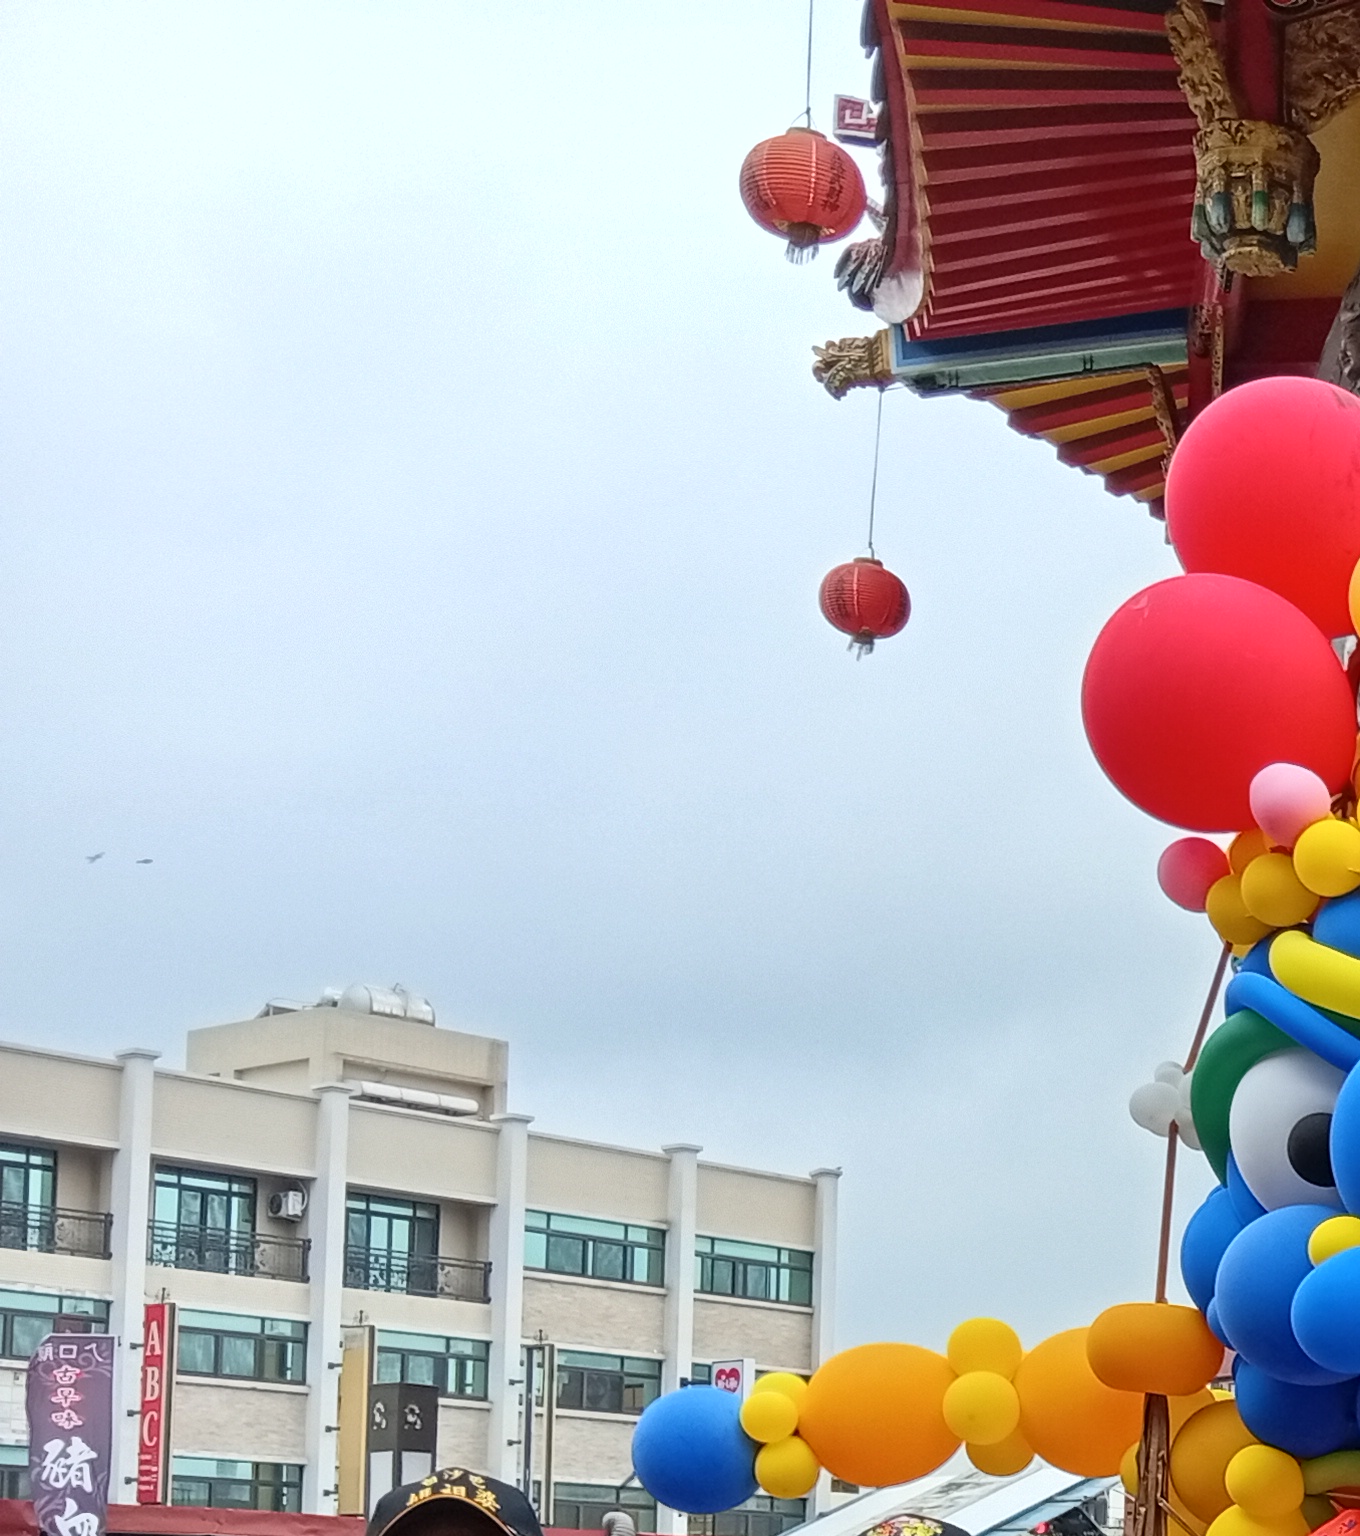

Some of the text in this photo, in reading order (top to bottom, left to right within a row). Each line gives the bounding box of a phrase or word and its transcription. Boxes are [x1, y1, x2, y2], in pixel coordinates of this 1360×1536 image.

[51, 1364, 84, 1430] 古早味
[142, 1320, 162, 1447] ABC
